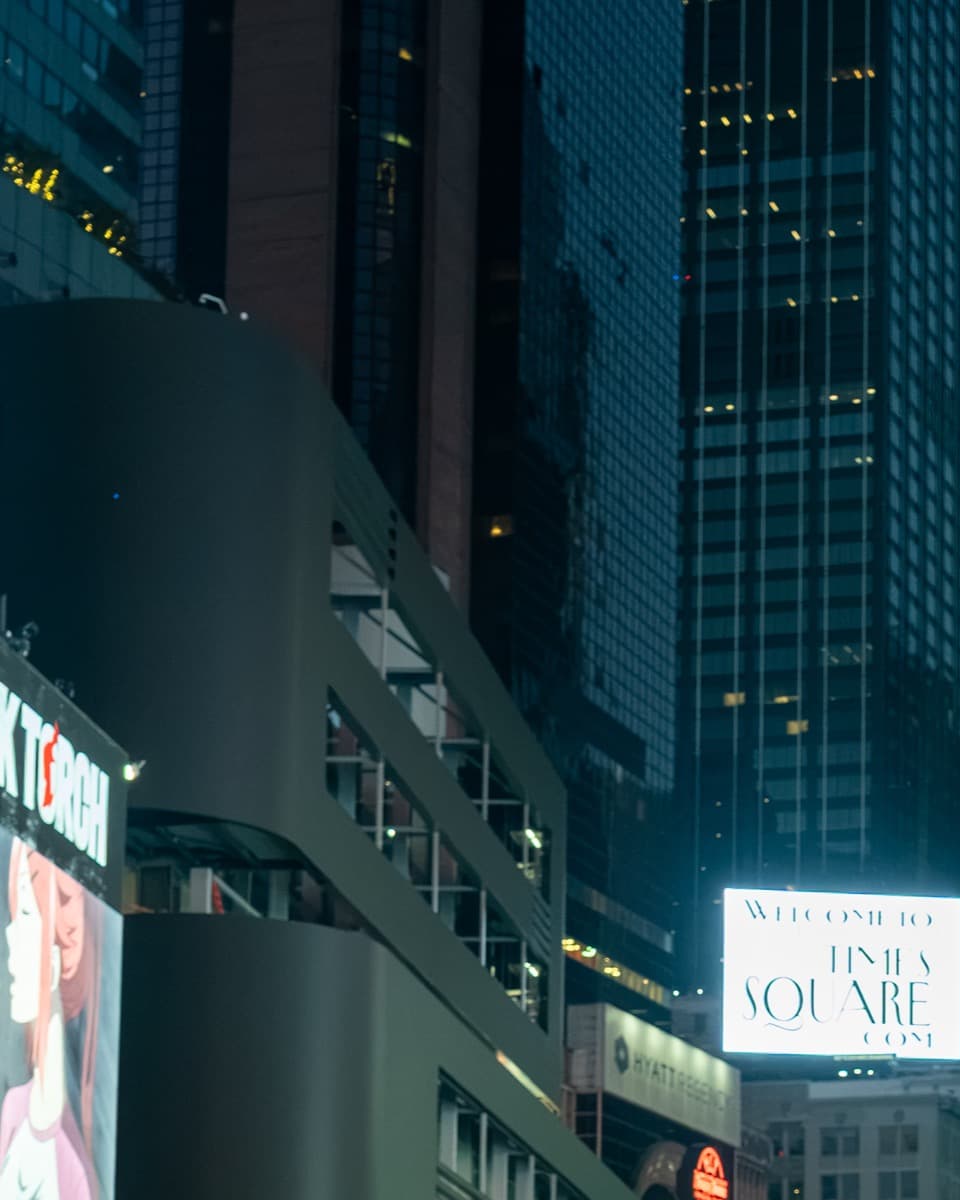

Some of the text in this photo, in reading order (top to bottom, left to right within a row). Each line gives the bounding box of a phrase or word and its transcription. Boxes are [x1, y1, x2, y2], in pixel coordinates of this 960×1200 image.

[20, 701, 110, 868] TORCH
[830, 945, 932, 977] TIMES
[742, 975, 932, 1031] SQUARE
[633, 1052, 676, 1089] HYATT
